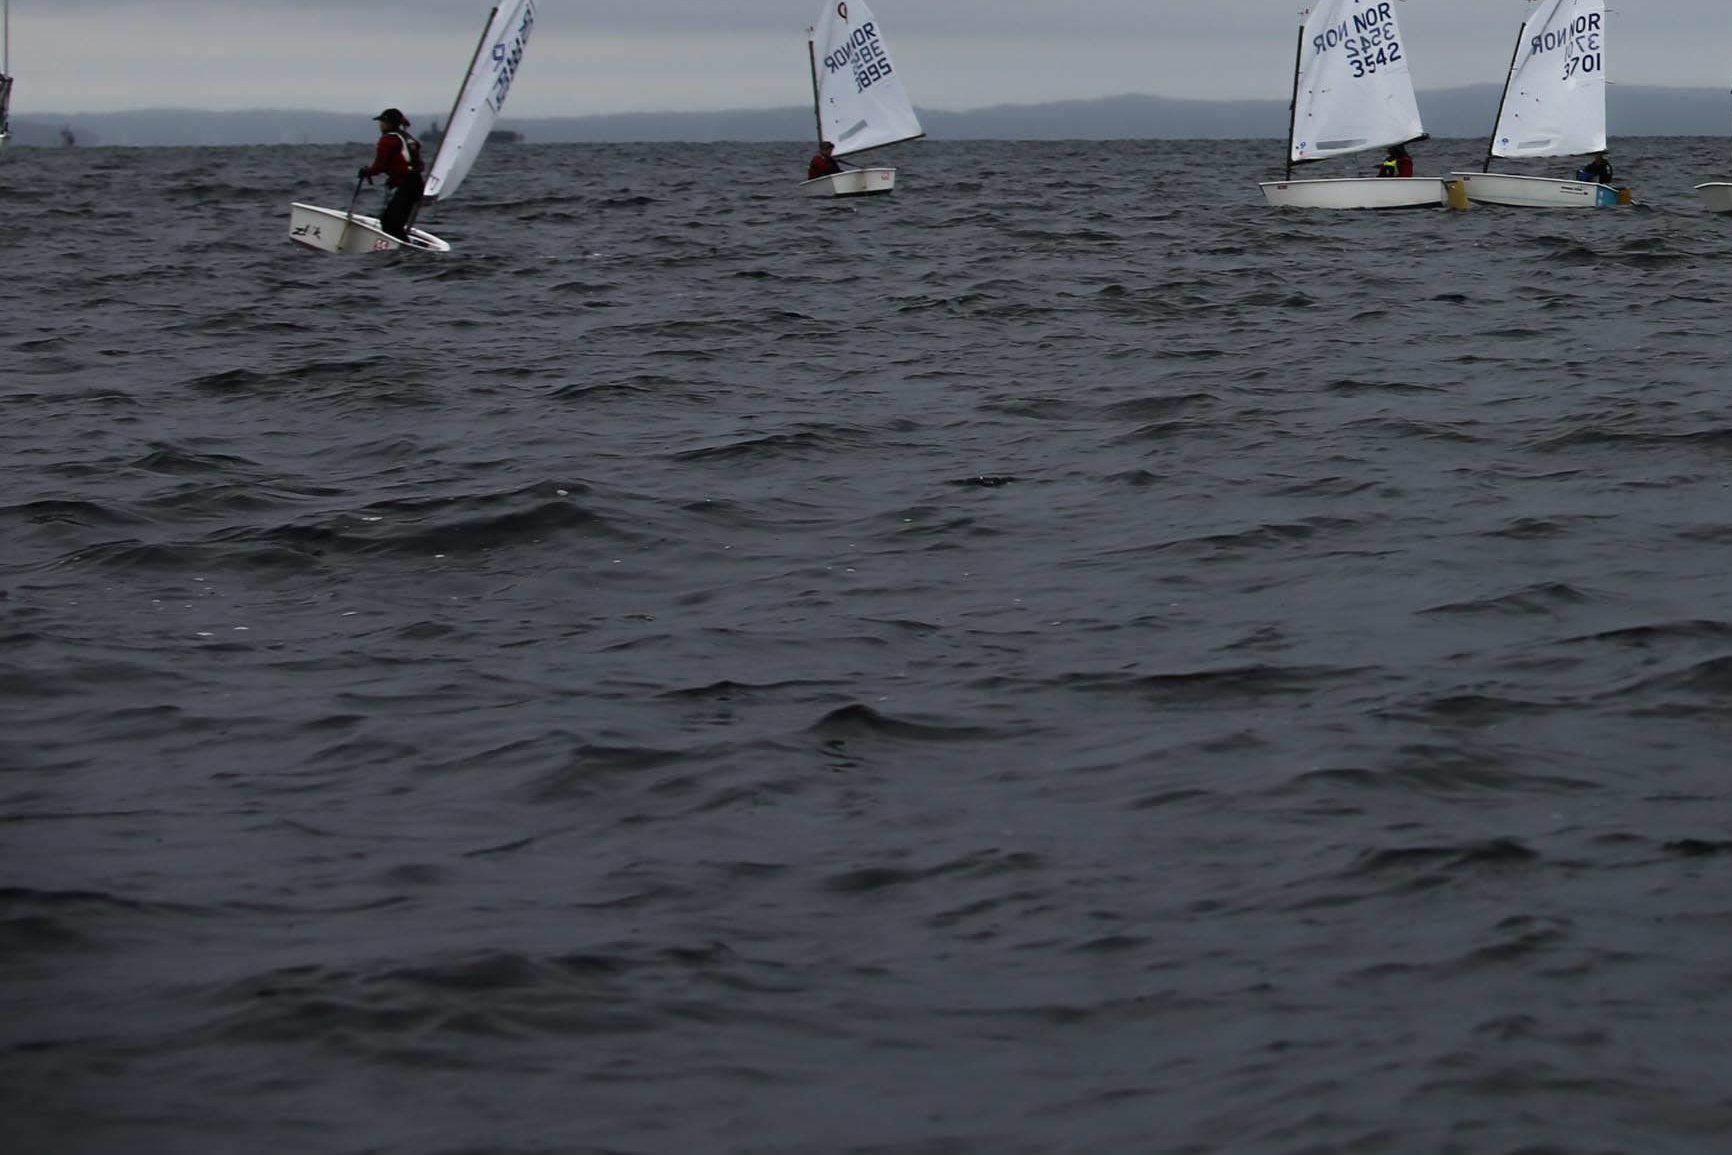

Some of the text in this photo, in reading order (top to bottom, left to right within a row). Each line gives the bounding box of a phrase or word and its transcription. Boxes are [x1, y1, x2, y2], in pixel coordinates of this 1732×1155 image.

[1352, 2, 1391, 34] NOR
[1569, 12, 1601, 40] NOR
[1350, 42, 1402, 78] 3542
[1562, 52, 1601, 81] 3701
